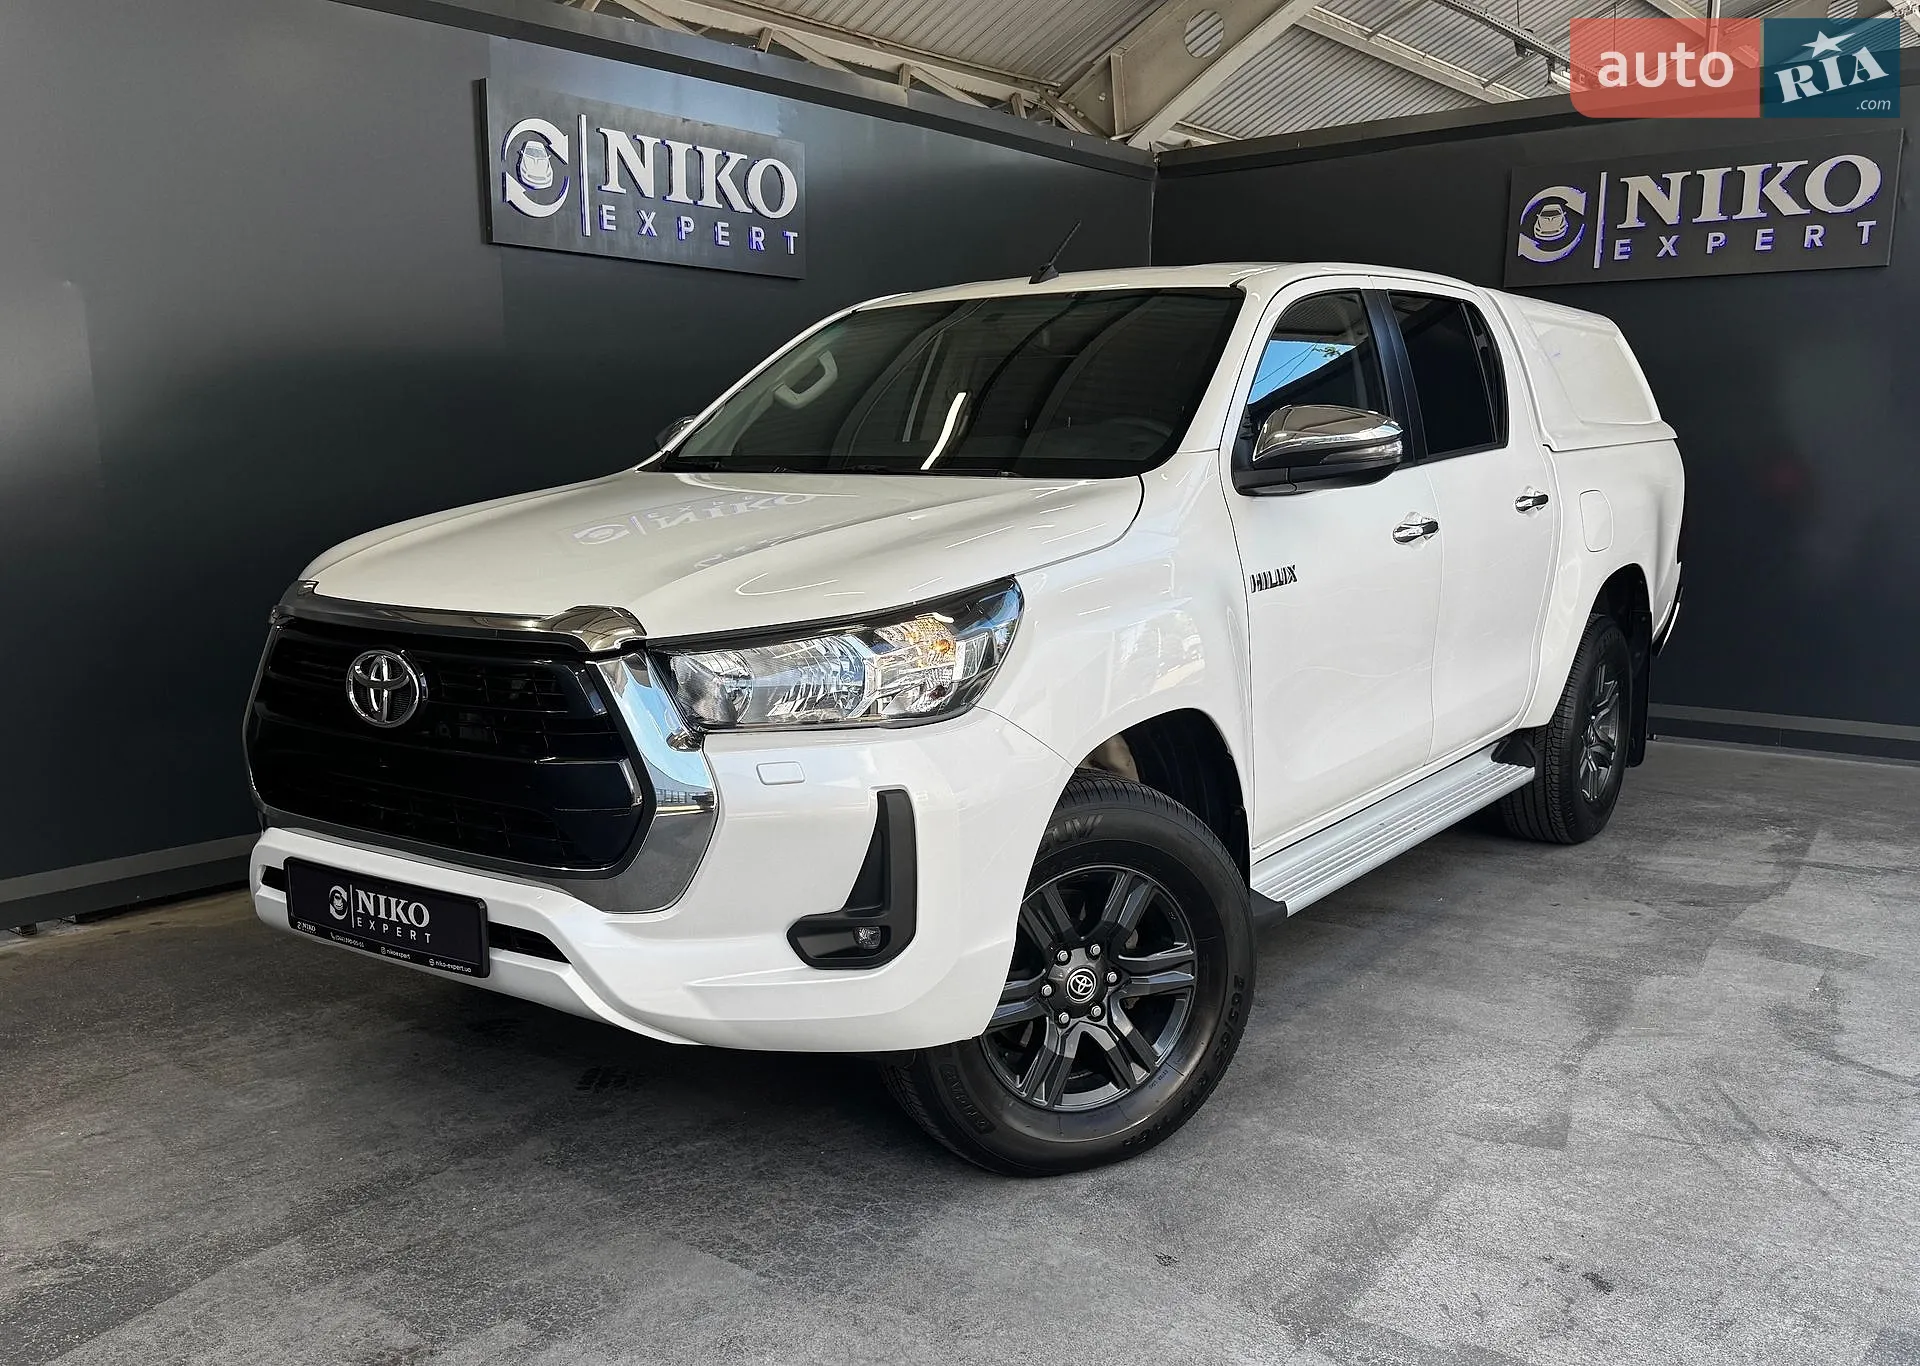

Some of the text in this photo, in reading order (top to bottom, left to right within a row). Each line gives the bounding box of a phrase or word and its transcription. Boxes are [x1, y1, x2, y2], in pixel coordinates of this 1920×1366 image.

[596, 127, 798, 219] NIKO
[1616, 154, 1882, 230] NIKO
[600, 204, 798, 255] EXPERT
[1613, 220, 1878, 261] EXPERT
[1249, 564, 1298, 594] HILUX
[355, 888, 430, 928] NIKO
[357, 917, 431, 944] EXPERT
